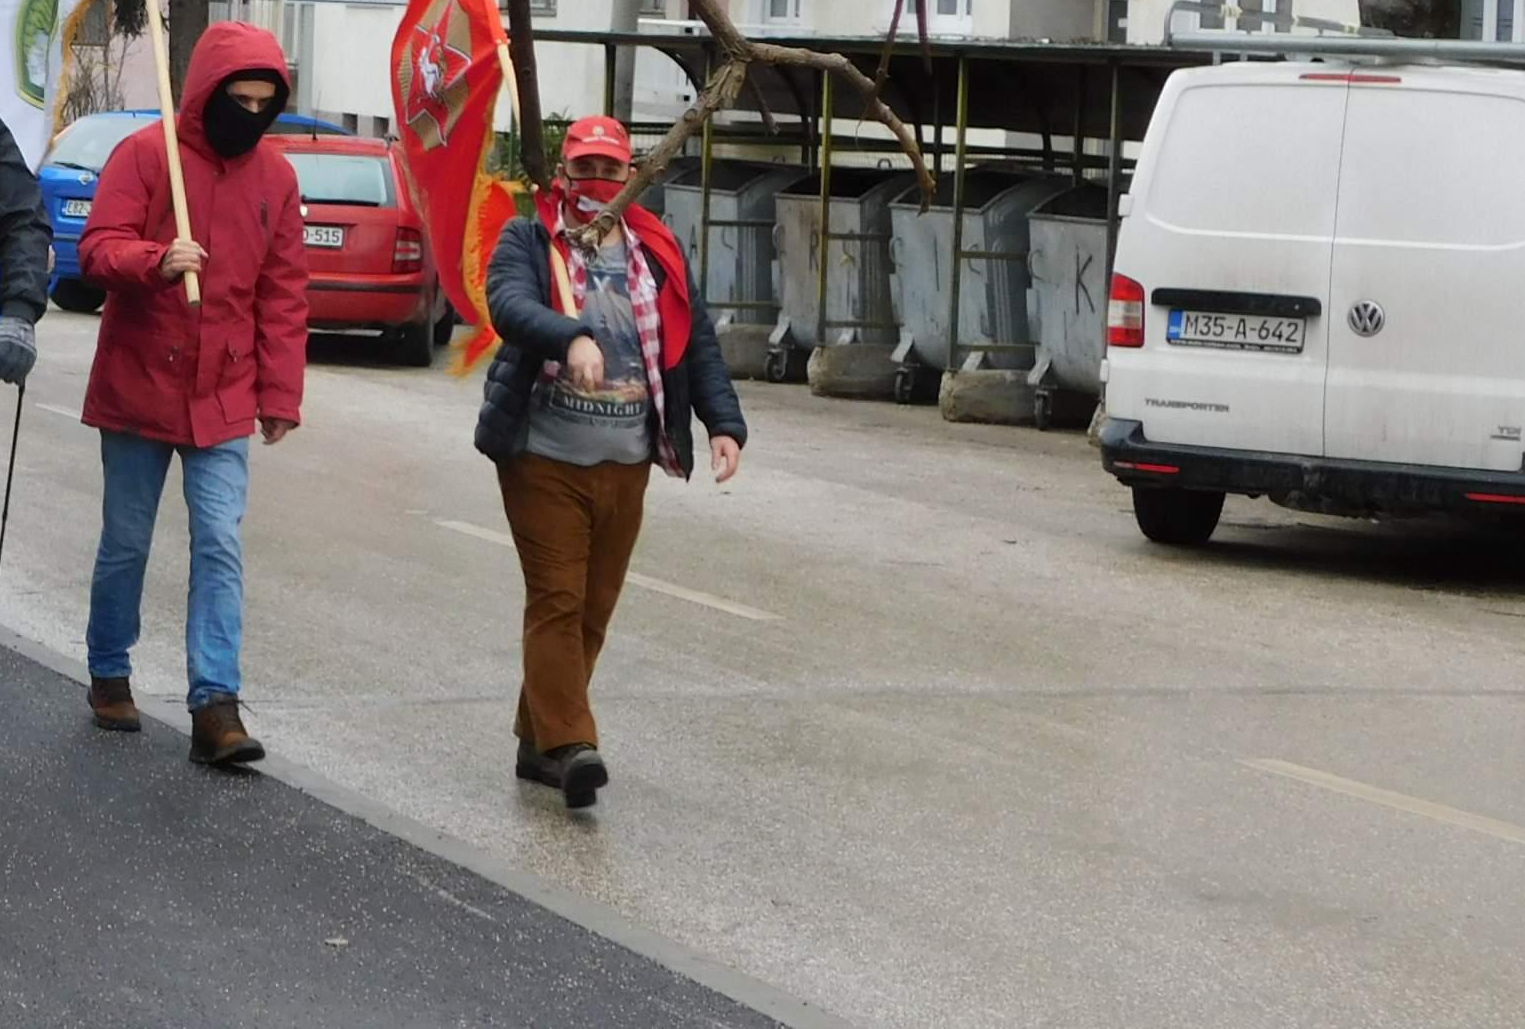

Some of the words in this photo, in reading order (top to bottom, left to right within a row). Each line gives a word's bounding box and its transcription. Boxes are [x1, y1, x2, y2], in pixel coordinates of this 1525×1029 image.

[1075, 246, 1096, 316] K
[1184, 314, 1299, 343] M35-A-642
[563, 395, 641, 416] MIDNIGHT
[1144, 398, 1230, 412] TRANSPORTER
